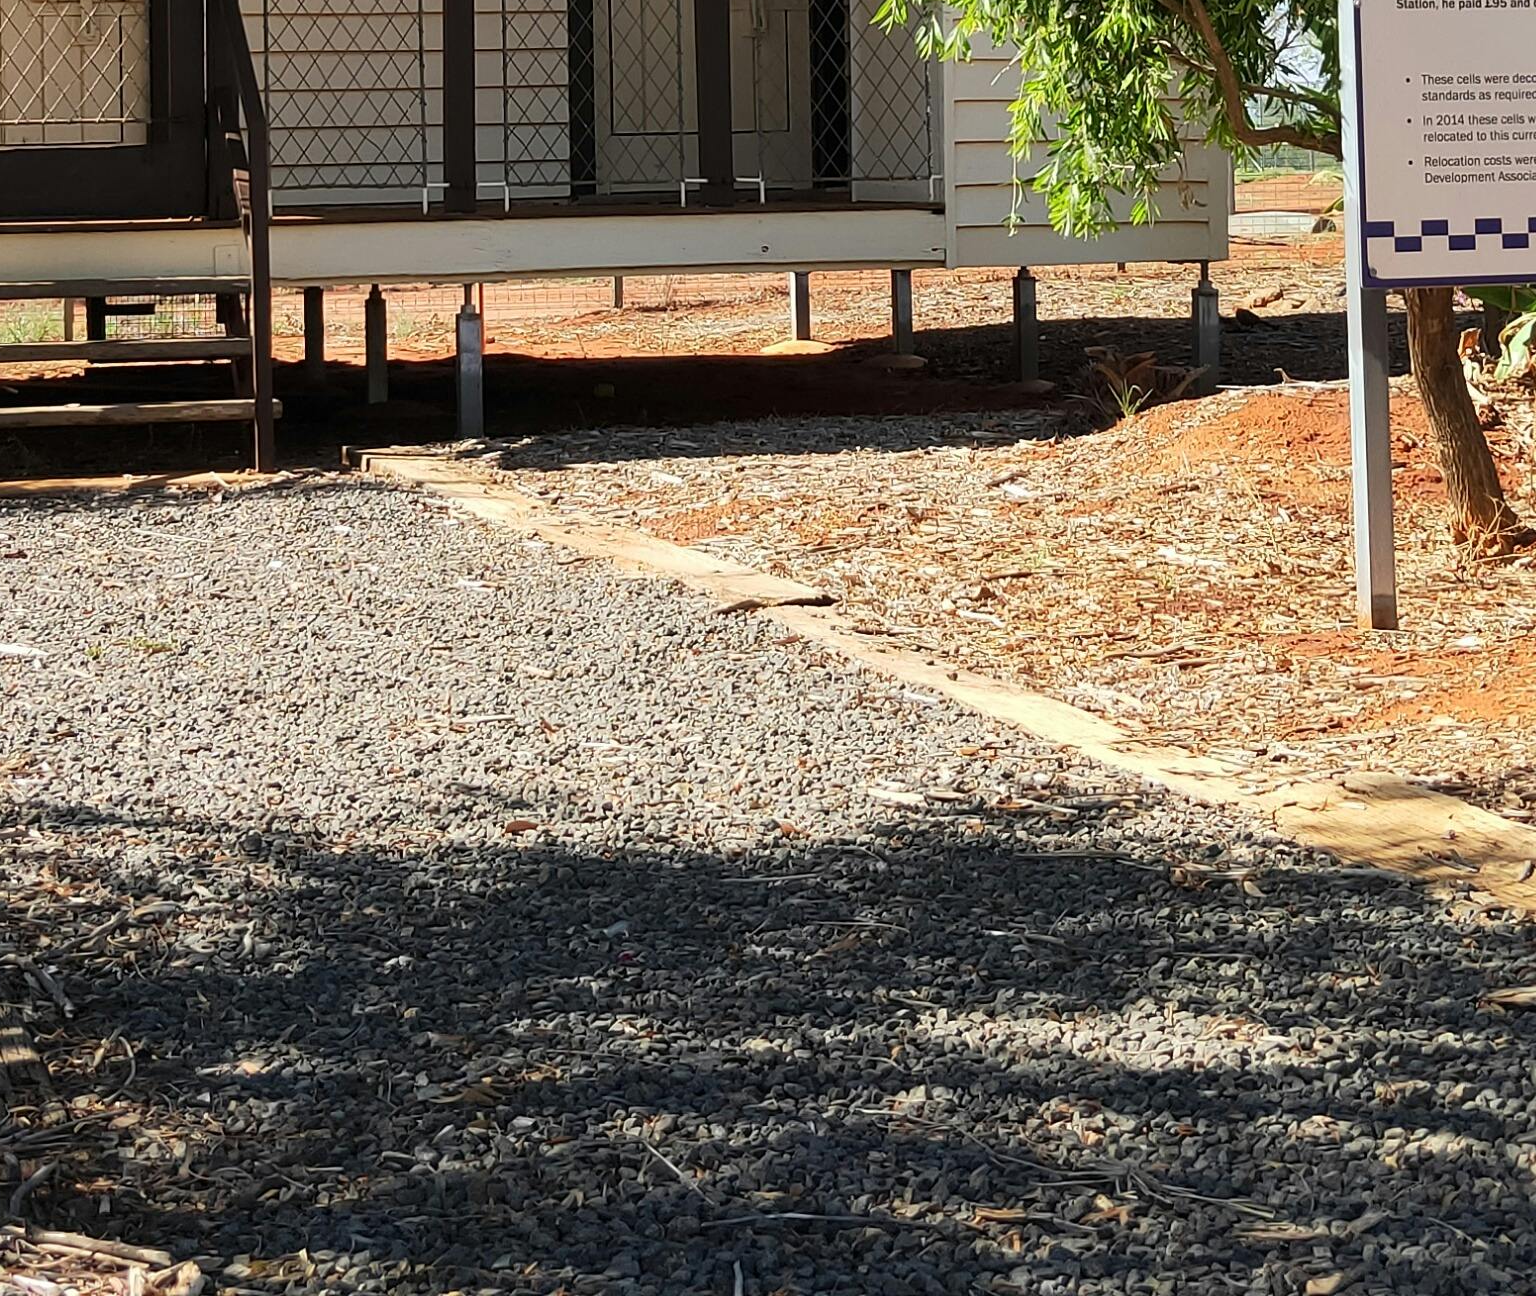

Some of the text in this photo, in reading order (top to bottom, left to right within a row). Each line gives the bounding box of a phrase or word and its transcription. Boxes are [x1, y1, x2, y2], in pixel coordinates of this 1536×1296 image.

[1420, 74, 1454, 85] These
[1456, 73, 1481, 84] cells
[1483, 75, 1510, 84] were
[1421, 89, 1476, 101] standards
[1478, 91, 1491, 100] as
[1422, 114, 1433, 126] In
[1435, 114, 1464, 125] 2014
[1467, 114, 1498, 125] these
[1500, 113, 1525, 124] cells
[1424, 155, 1480, 167] Relocation
[1483, 155, 1512, 165] costs
[1424, 172, 1496, 185] Development
